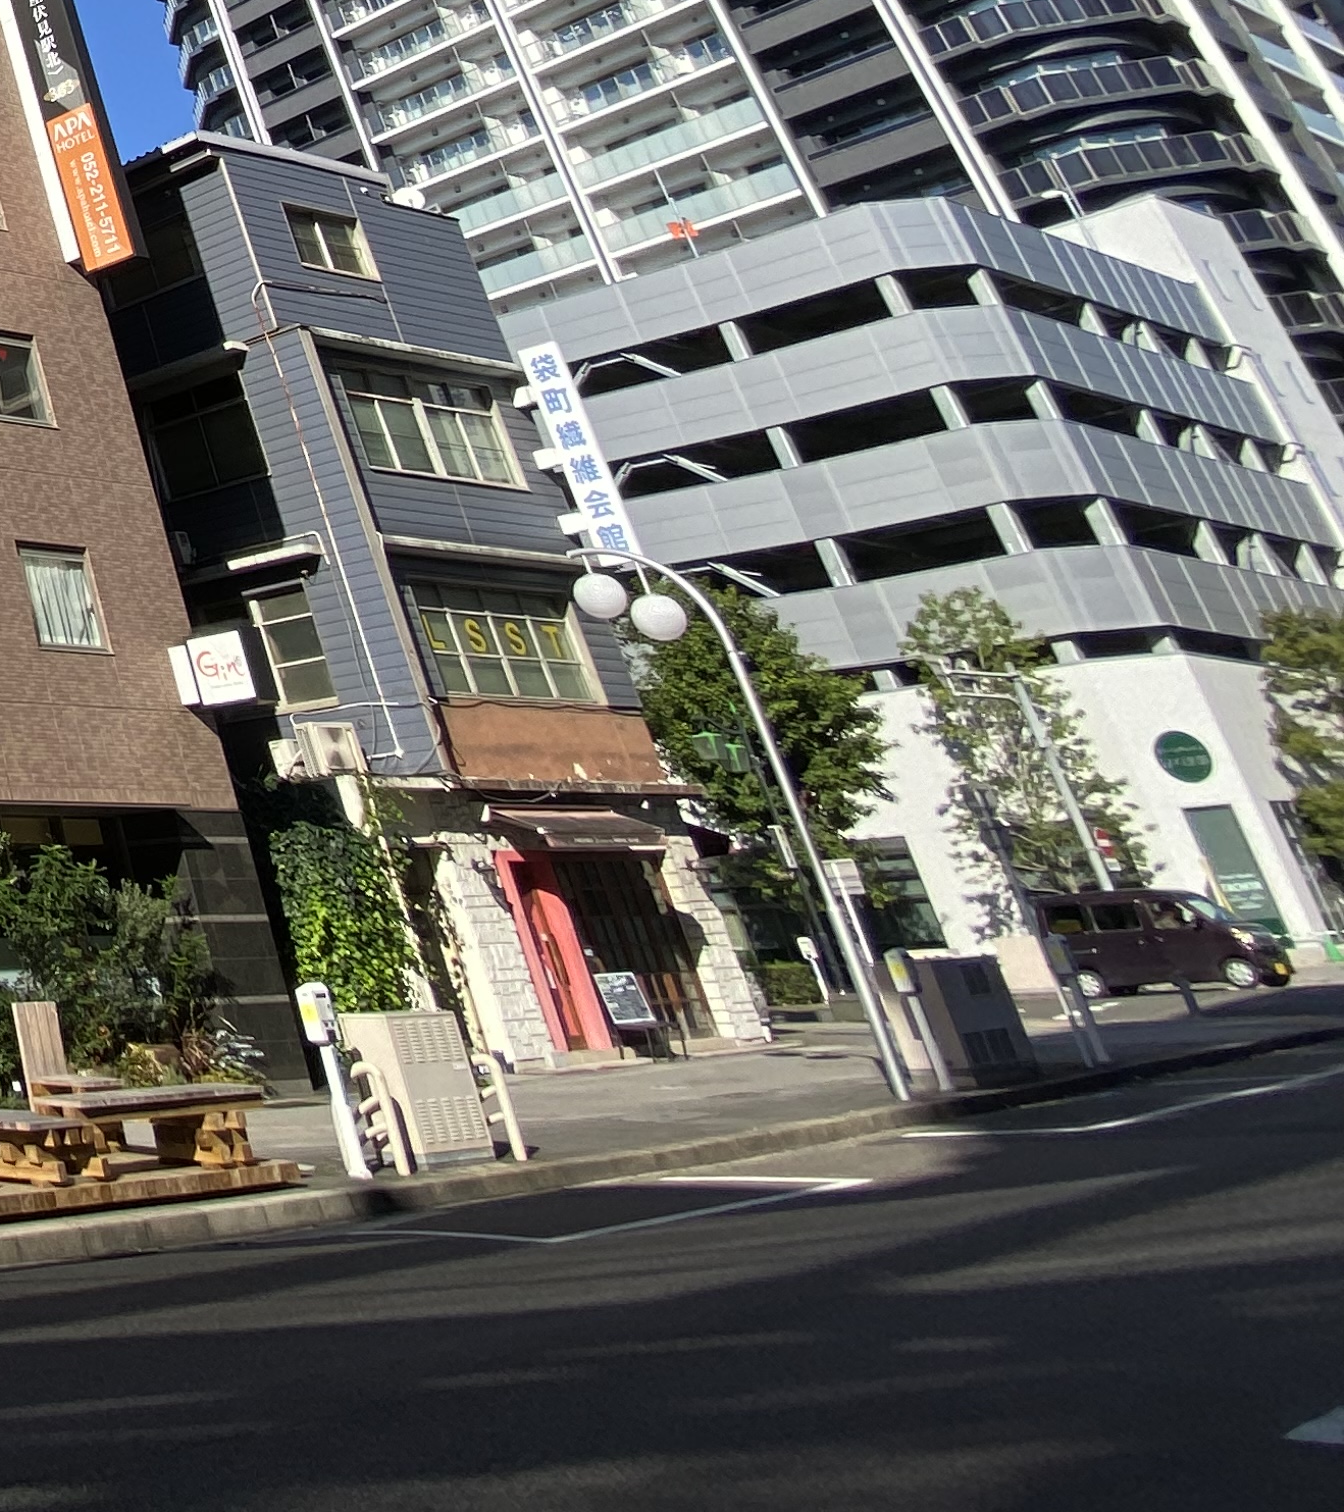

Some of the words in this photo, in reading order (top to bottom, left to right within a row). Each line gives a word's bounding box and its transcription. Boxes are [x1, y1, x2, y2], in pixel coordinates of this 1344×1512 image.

[54, 111, 92, 142] APA
[55, 129, 96, 155] HOTEL
[69, 159, 102, 258] www.apahotel.com
[80, 151, 121, 254] 052-211-5711
